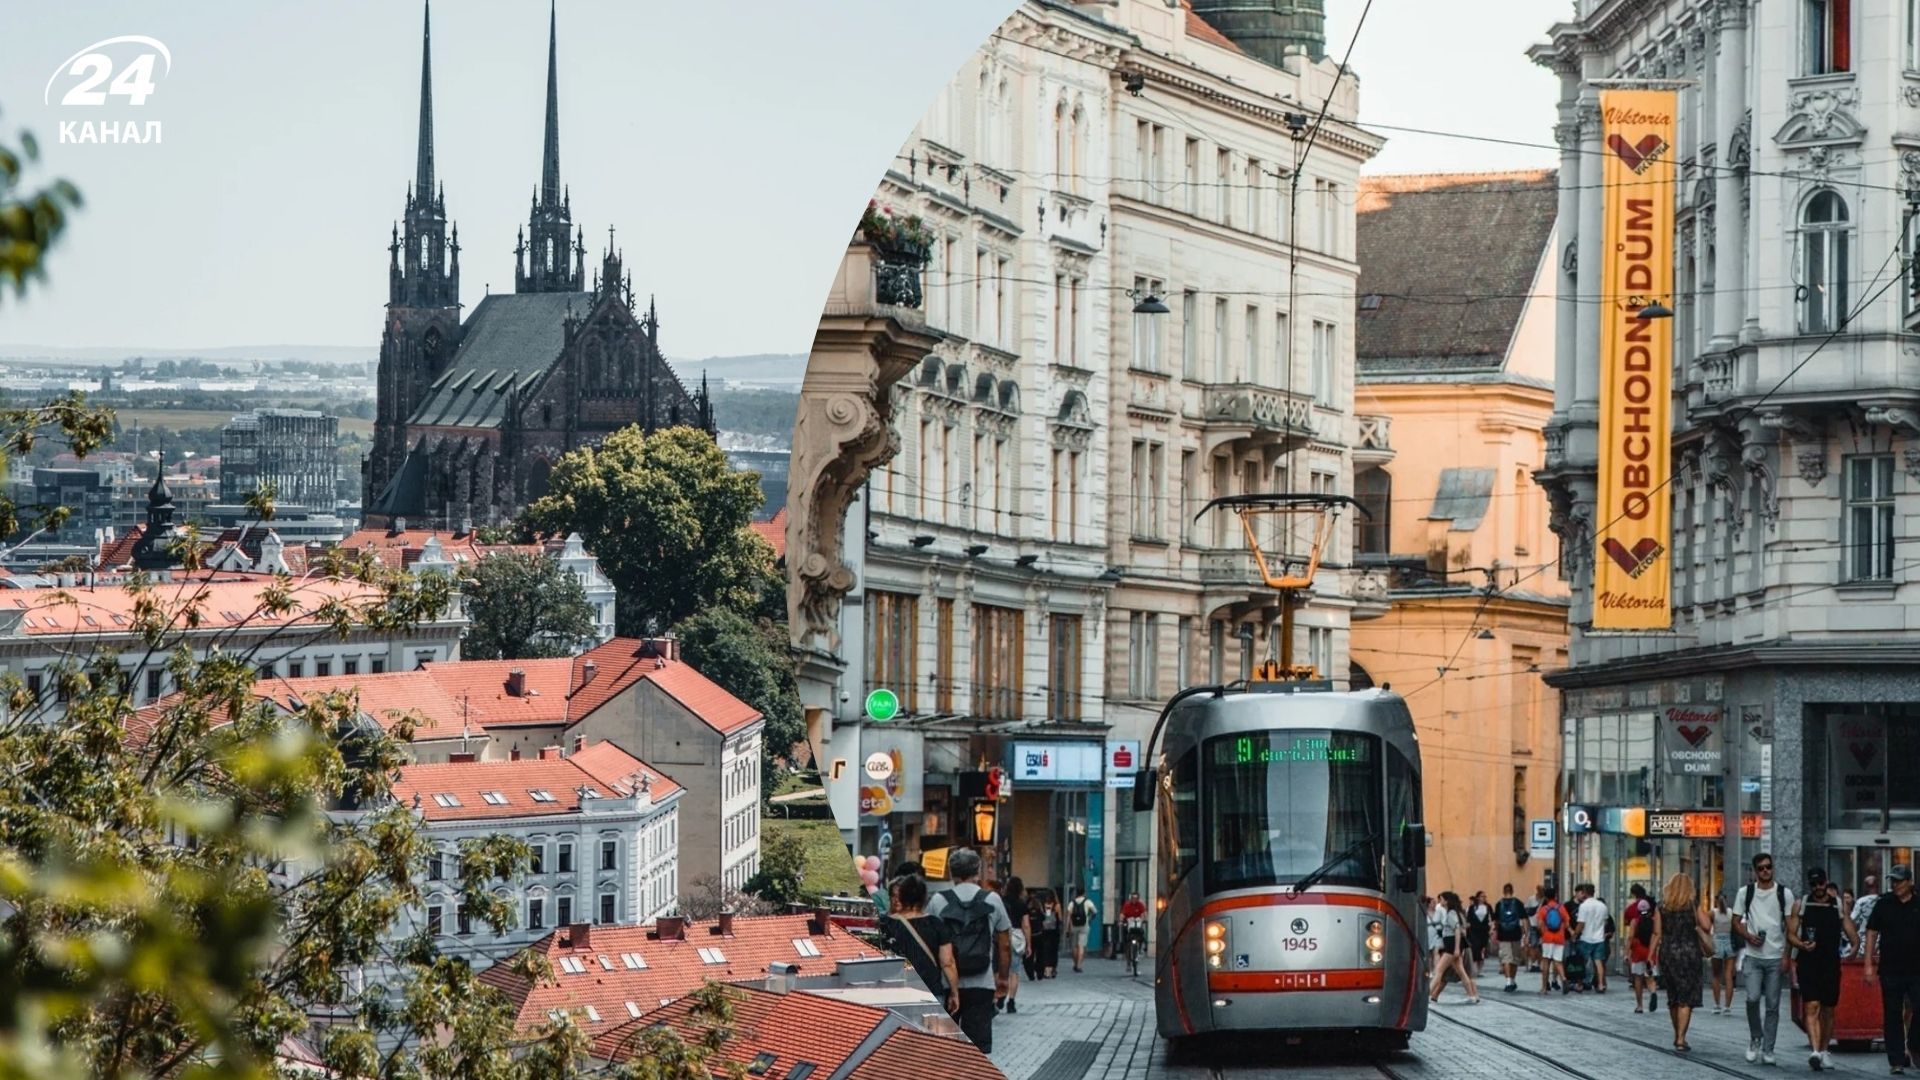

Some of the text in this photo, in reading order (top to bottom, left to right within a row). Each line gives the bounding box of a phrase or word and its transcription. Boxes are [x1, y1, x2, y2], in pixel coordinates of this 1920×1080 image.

[1605, 106, 1672, 126] Viktoria
[1616, 198, 1653, 291] DŮM
[1599, 591, 1666, 609] Viktoria
[1665, 707, 1721, 723] Viktoria
[861, 797, 887, 809] eta
[1282, 937, 1318, 952] 1945
